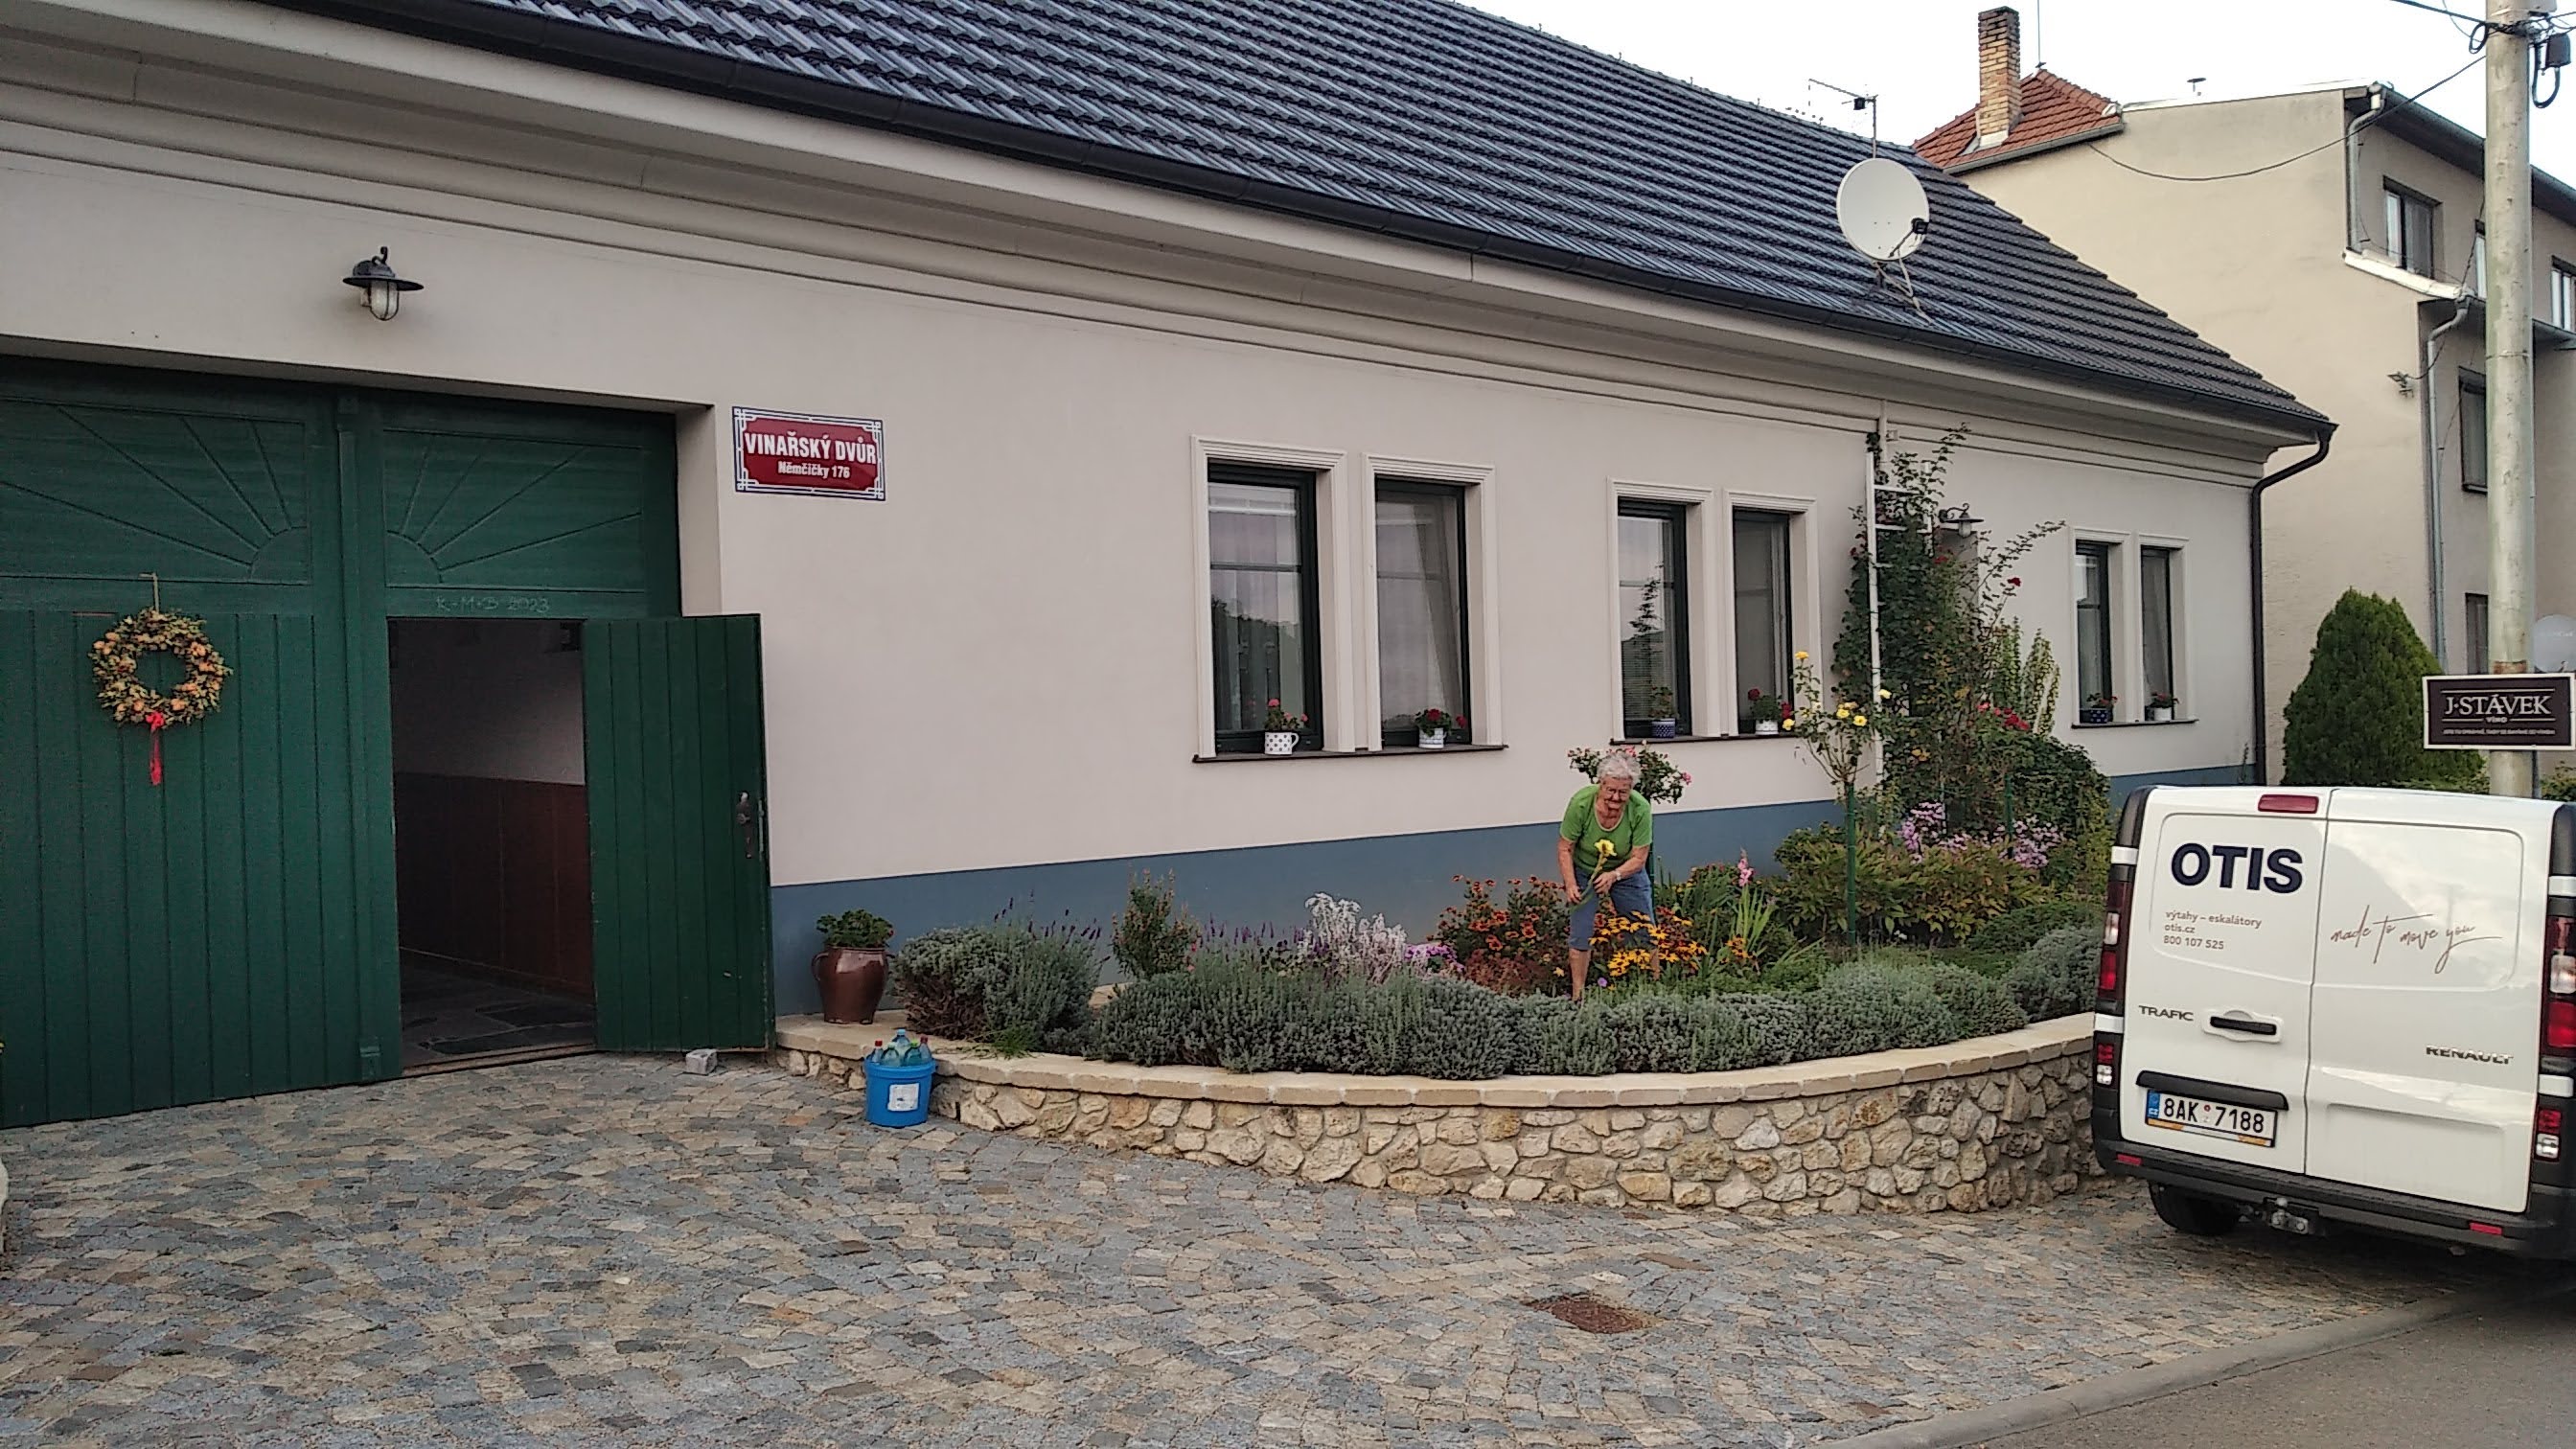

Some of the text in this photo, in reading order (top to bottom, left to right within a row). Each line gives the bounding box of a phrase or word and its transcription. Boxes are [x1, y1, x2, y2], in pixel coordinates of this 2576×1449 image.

[745, 430, 877, 464] VINAŘSKÝ DVŮR
[778, 461, 850, 479] Němčičky 176
[2172, 842, 2303, 893] OTIS
[2164, 923, 2196, 933] otis.cz
[2166, 910, 2198, 923] výtahy
[2208, 913, 2262, 930] eskalátory
[2163, 935, 2224, 950] 800 107 525
[2331, 905, 2371, 948] made
[2400, 927, 2438, 950] move
[2434, 925, 2503, 975] you
[2138, 1004, 2195, 1022] TRAFIC
[2426, 1045, 2514, 1065] RENAULT
[2163, 1098, 2265, 1134] 8AK 7188
